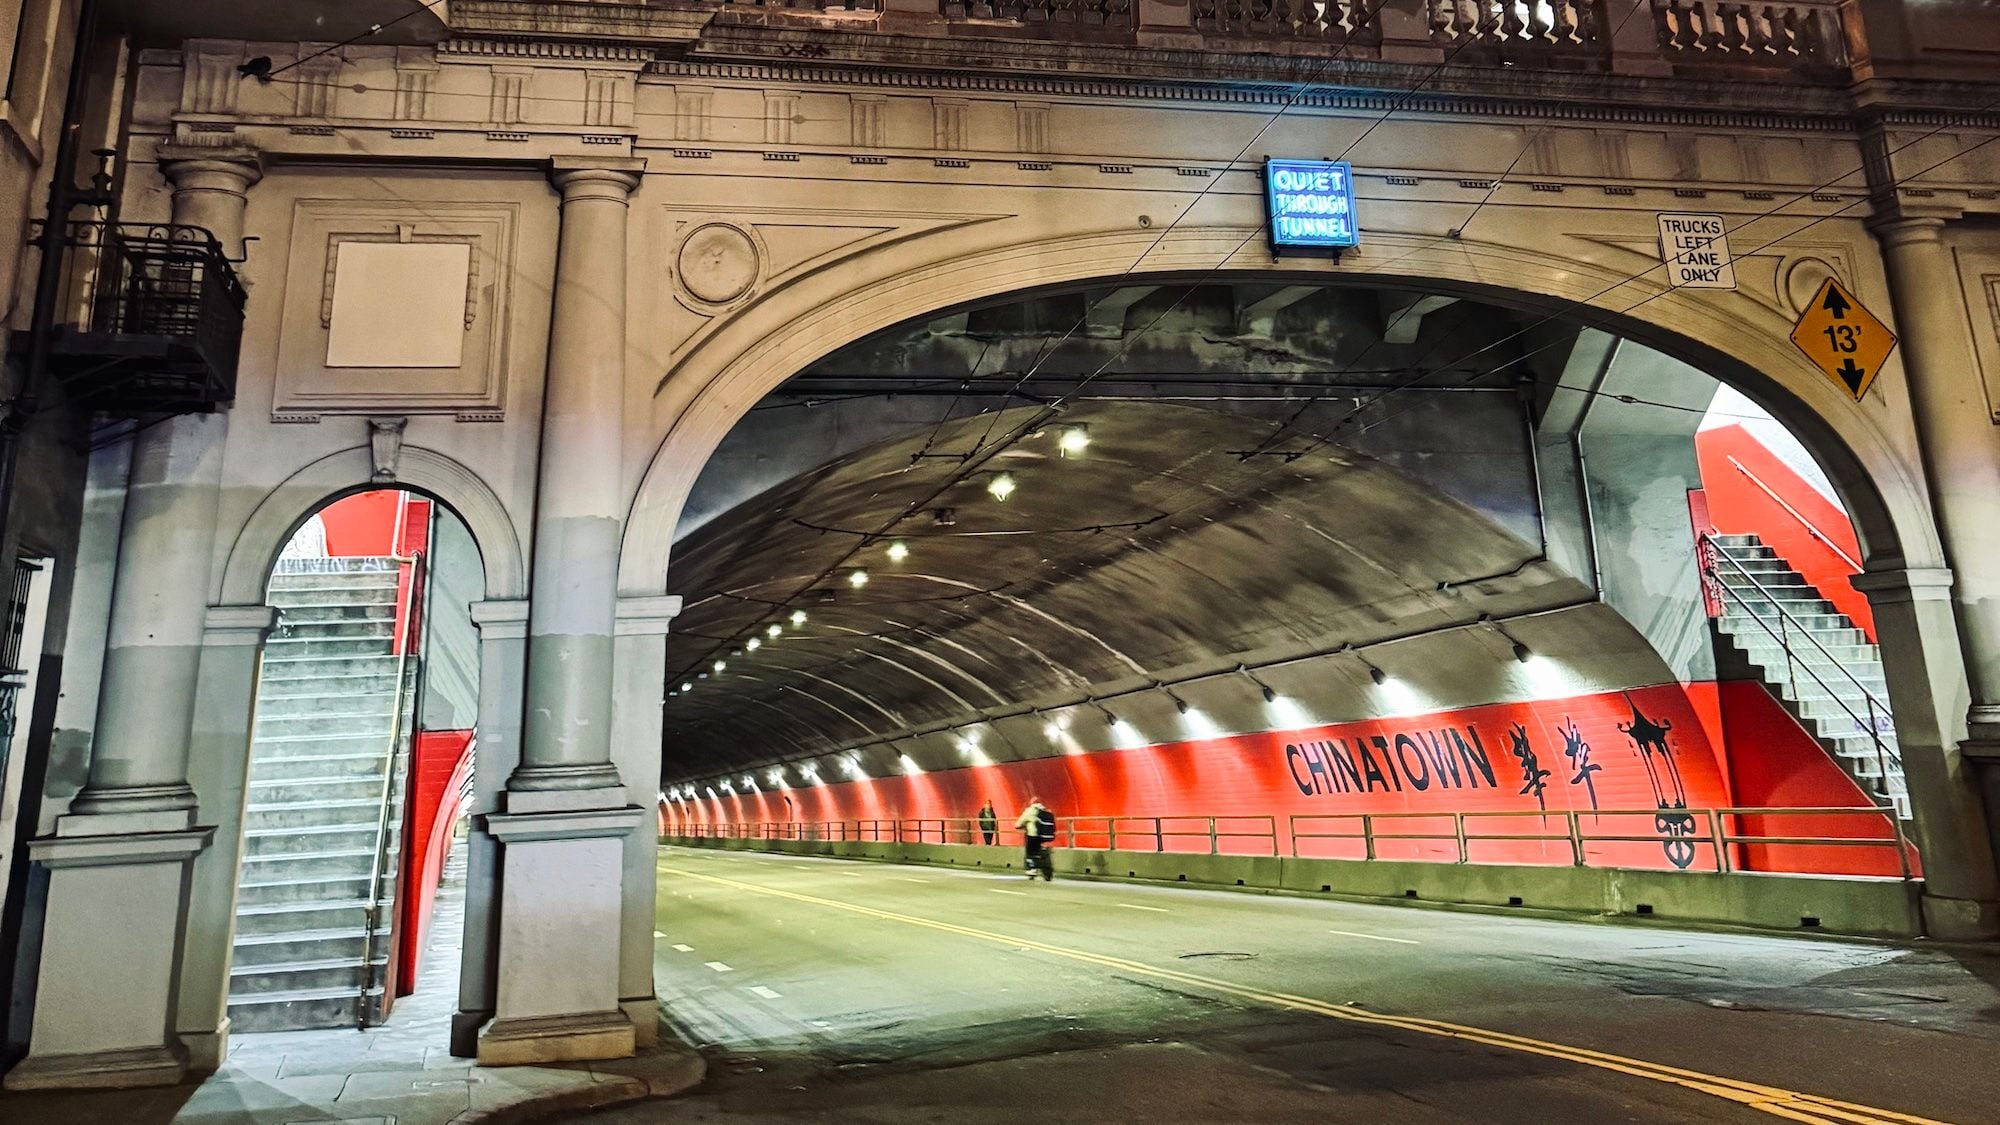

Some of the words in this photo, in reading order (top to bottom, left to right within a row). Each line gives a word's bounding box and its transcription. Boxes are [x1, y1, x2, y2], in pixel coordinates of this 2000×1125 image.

[1274, 170, 1343, 191] QUIET
[1276, 194, 1348, 215] THROUGH
[1278, 217, 1351, 237] TUNNEL
[1663, 219, 1720, 233] TRUCKS
[1675, 235, 1713, 249] LEFT
[1676, 252, 1720, 265] LANE
[1681, 268, 1720, 282] ONLY
[1823, 325, 1861, 352] 13'
[1286, 725, 1498, 796] CHINATOWN
